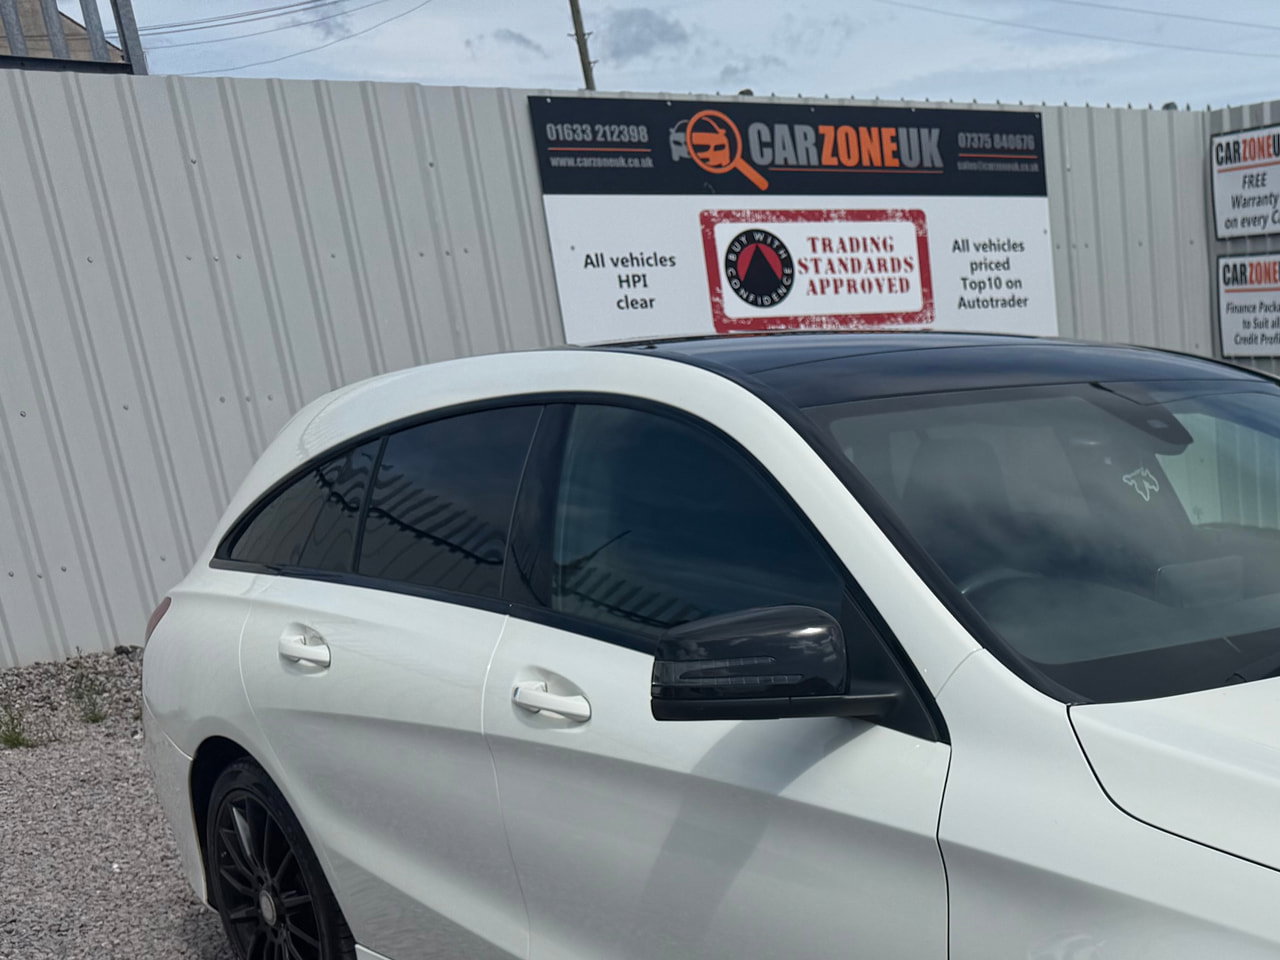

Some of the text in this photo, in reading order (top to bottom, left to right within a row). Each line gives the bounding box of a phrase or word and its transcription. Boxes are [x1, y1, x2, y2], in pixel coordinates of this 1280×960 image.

[546, 123, 649, 143] 01633 212398
[958, 132, 992, 149] 07375
[747, 122, 944, 168] CARZONEUK
[1242, 172, 1267, 190] FREE
[1231, 192, 1279, 209] Warranty
[1224, 217, 1239, 229] on
[1241, 214, 1269, 230] every
[729, 231, 787, 262] BUY WITH
[807, 236, 894, 254] TRADING
[952, 238, 1025, 253] All vehicles
[584, 251, 676, 269] All vehicles
[798, 256, 914, 275] STANDARDS
[970, 257, 1010, 275] priced
[618, 273, 648, 288] HPI
[727, 267, 793, 306] CONFIDENCE
[806, 277, 910, 296] APPROVED
[961, 277, 1022, 294] Top10 on
[616, 294, 656, 310] clear
[958, 294, 1029, 310] Autotrader
[1226, 301, 1256, 315] Finance
[1242, 317, 1280, 329] to Suit all
[1234, 333, 1258, 345] Credit
